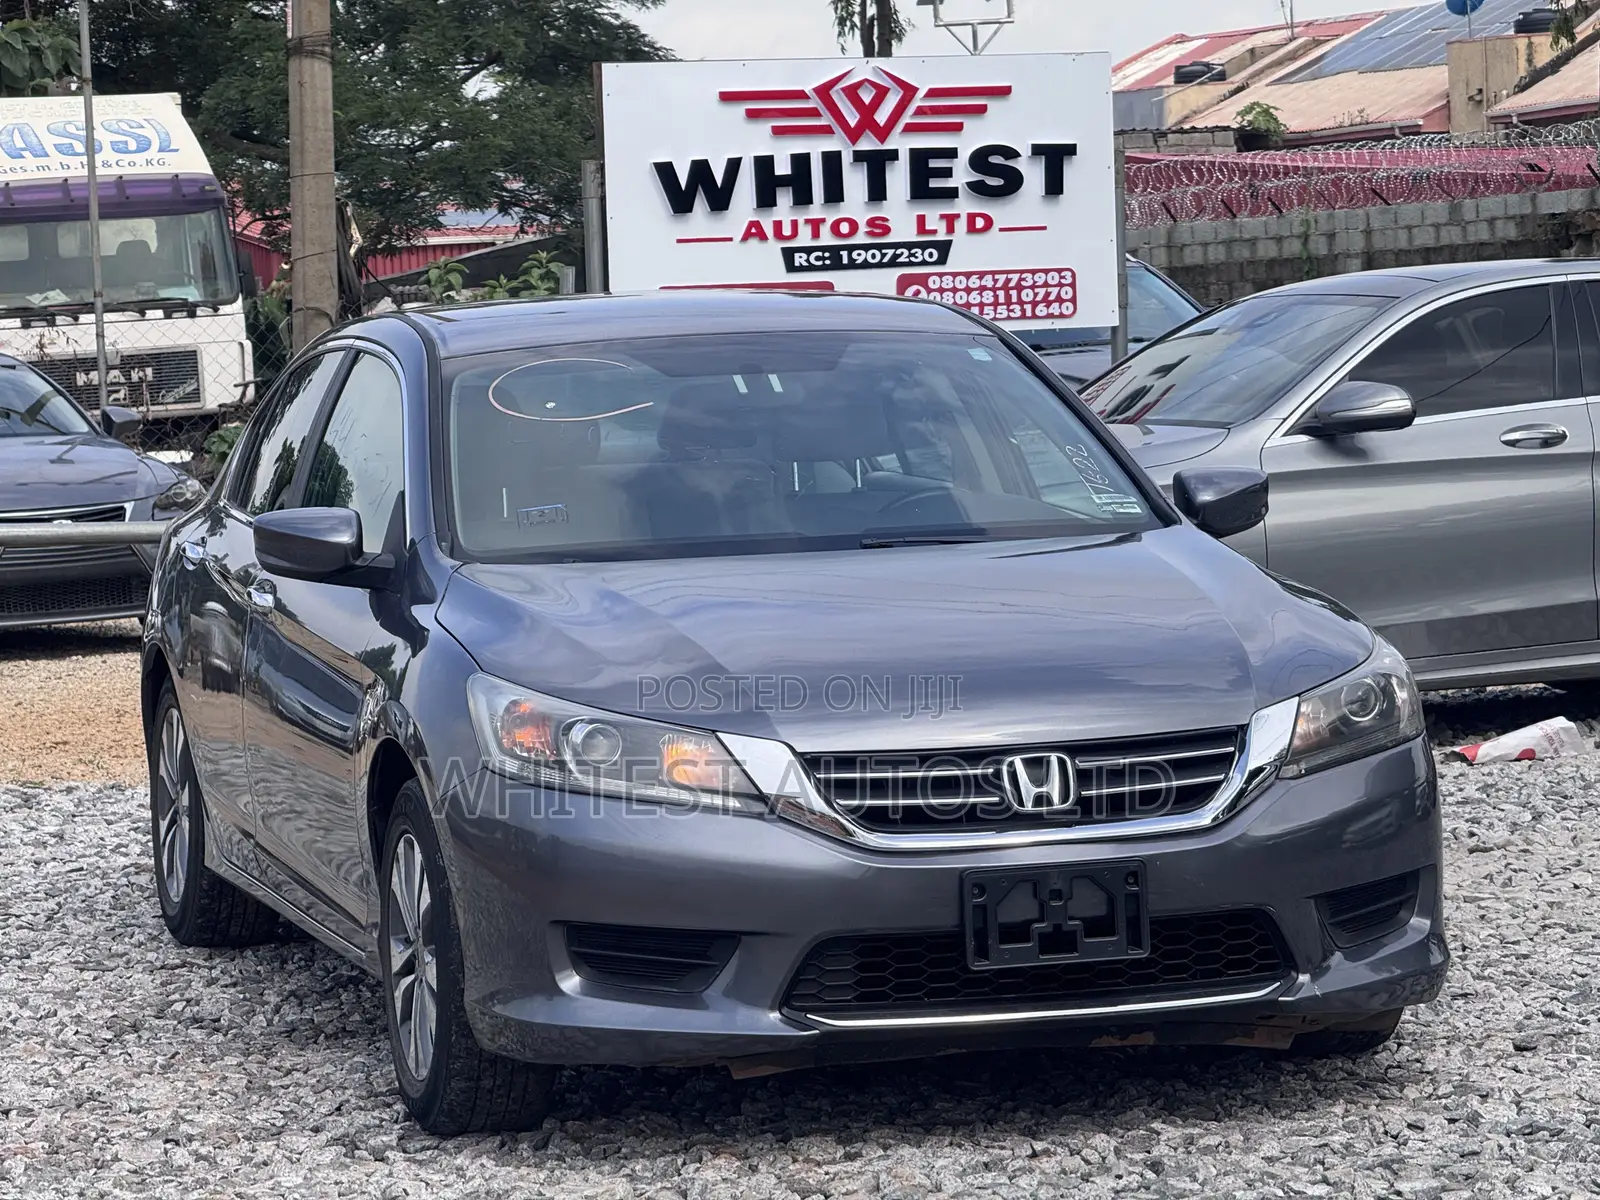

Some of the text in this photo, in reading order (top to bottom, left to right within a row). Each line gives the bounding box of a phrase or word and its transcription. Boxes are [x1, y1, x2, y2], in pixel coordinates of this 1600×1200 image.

[651, 142, 1078, 215] WHITEST
[740, 212, 994, 242] AUTOS LTD
[793, 248, 939, 268] RC: 1907230
[927, 271, 1073, 290] 08064773903
[928, 286, 1074, 304] 08068110770
